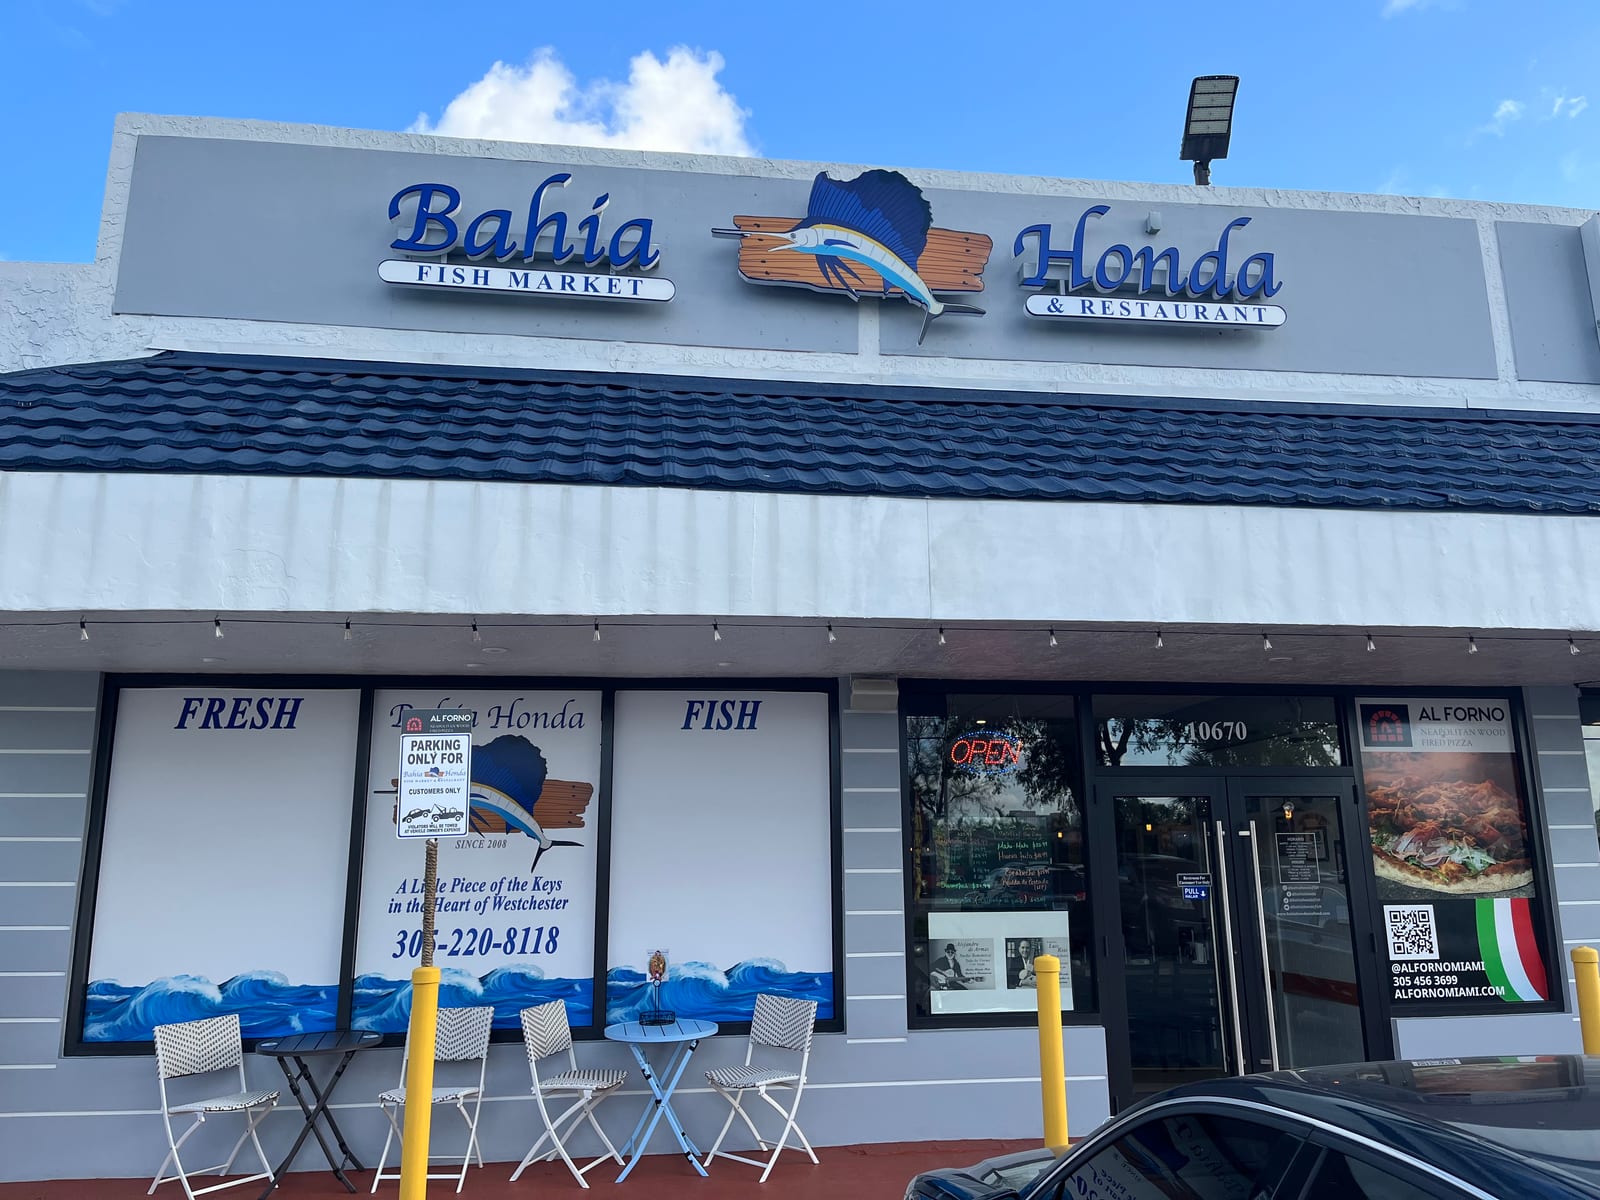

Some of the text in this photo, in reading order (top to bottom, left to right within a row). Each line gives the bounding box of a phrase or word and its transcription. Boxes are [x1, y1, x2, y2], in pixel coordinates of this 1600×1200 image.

[1013, 205, 1283, 298] Honda
[416, 265, 643, 296] FISH MARKET
[1046, 297, 1267, 322] & RESTAURANT
[174, 697, 304, 730] FRESH
[430, 714, 471, 722] AL FORNO
[487, 697, 585, 729] Honda
[681, 700, 762, 731] FISH
[1418, 706, 1505, 721] AL FORNO
[1189, 721, 1248, 741] 10670
[1420, 728, 1506, 737] NEAPOLITAN WOOD
[411, 739, 460, 751] PARKING
[1421, 738, 1473, 747] FIRED PIZZA
[407, 752, 463, 765] ONLY FOR
[951, 739, 1022, 765] OPEN
[455, 839, 507, 849] SINCE 2008
[396, 876, 563, 896] A Lile Piece of the Keys
[1184, 887, 1200, 895] PULL
[388, 898, 402, 914] in
[474, 896, 490, 916] of
[493, 895, 569, 911] Westchester
[1391, 961, 1486, 974] @ALFORNOMIAMI
[1392, 975, 1458, 987] 305 456 3699
[1394, 985, 1506, 999] ALFORNOMIAMI.COM
